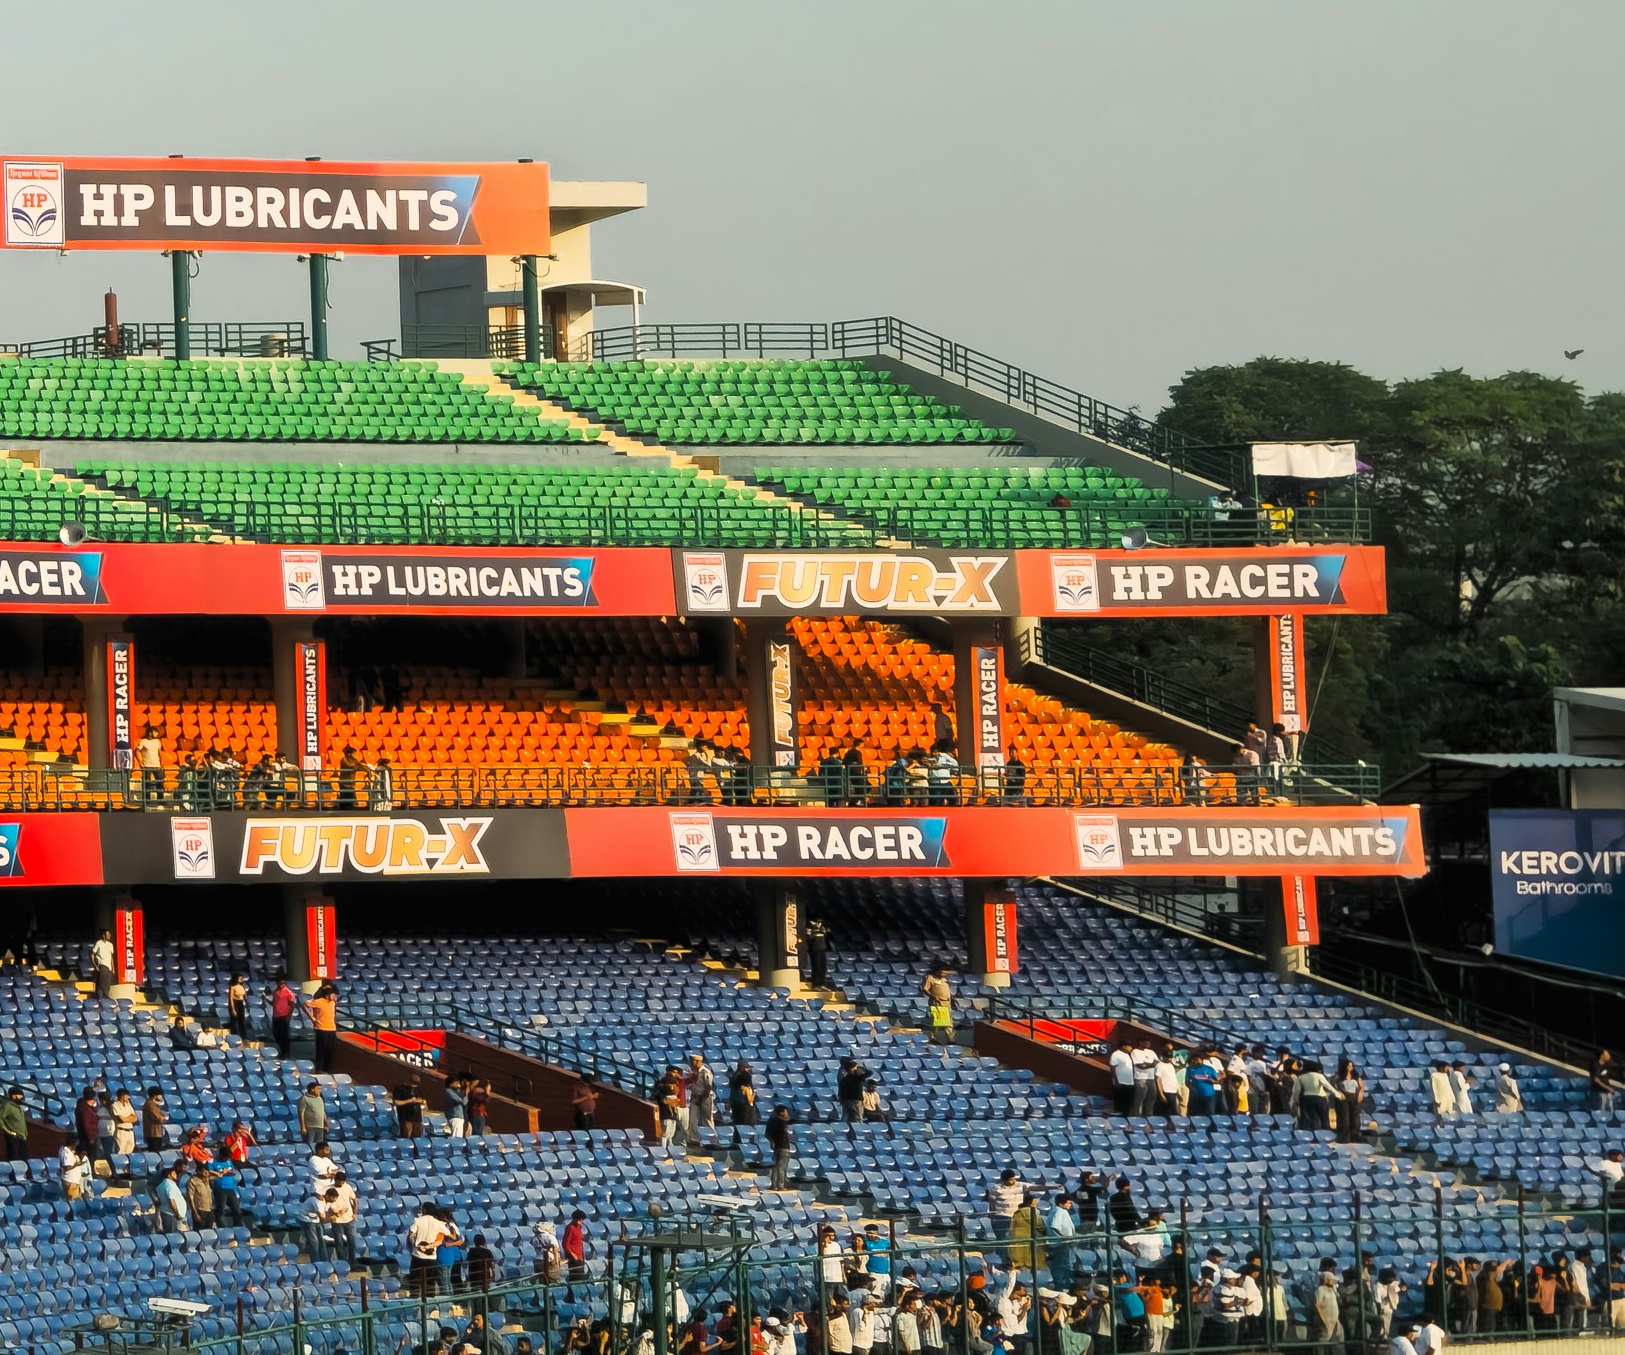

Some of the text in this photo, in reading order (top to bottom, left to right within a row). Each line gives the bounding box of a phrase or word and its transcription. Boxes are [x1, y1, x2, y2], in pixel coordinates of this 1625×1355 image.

[80, 183, 459, 232] HP LUBRICANTS
[332, 566, 584, 597] HP LUBRICANTS
[743, 555, 1003, 610] FUTUR-X
[1111, 564, 1319, 602] HP RACER
[114, 650, 129, 742] HP RACER
[305, 648, 318, 753] HP LUBRICANTS
[771, 644, 793, 746] FUTUR-X
[980, 658, 1000, 748] HP RACER
[243, 820, 487, 872] FUTUR-X
[727, 824, 926, 861] HP RACER
[1131, 827, 1396, 857] HP LUBRICANTS
[1501, 850, 1625, 875] KEROVIT
[1516, 880, 1613, 895] Bathrooms
